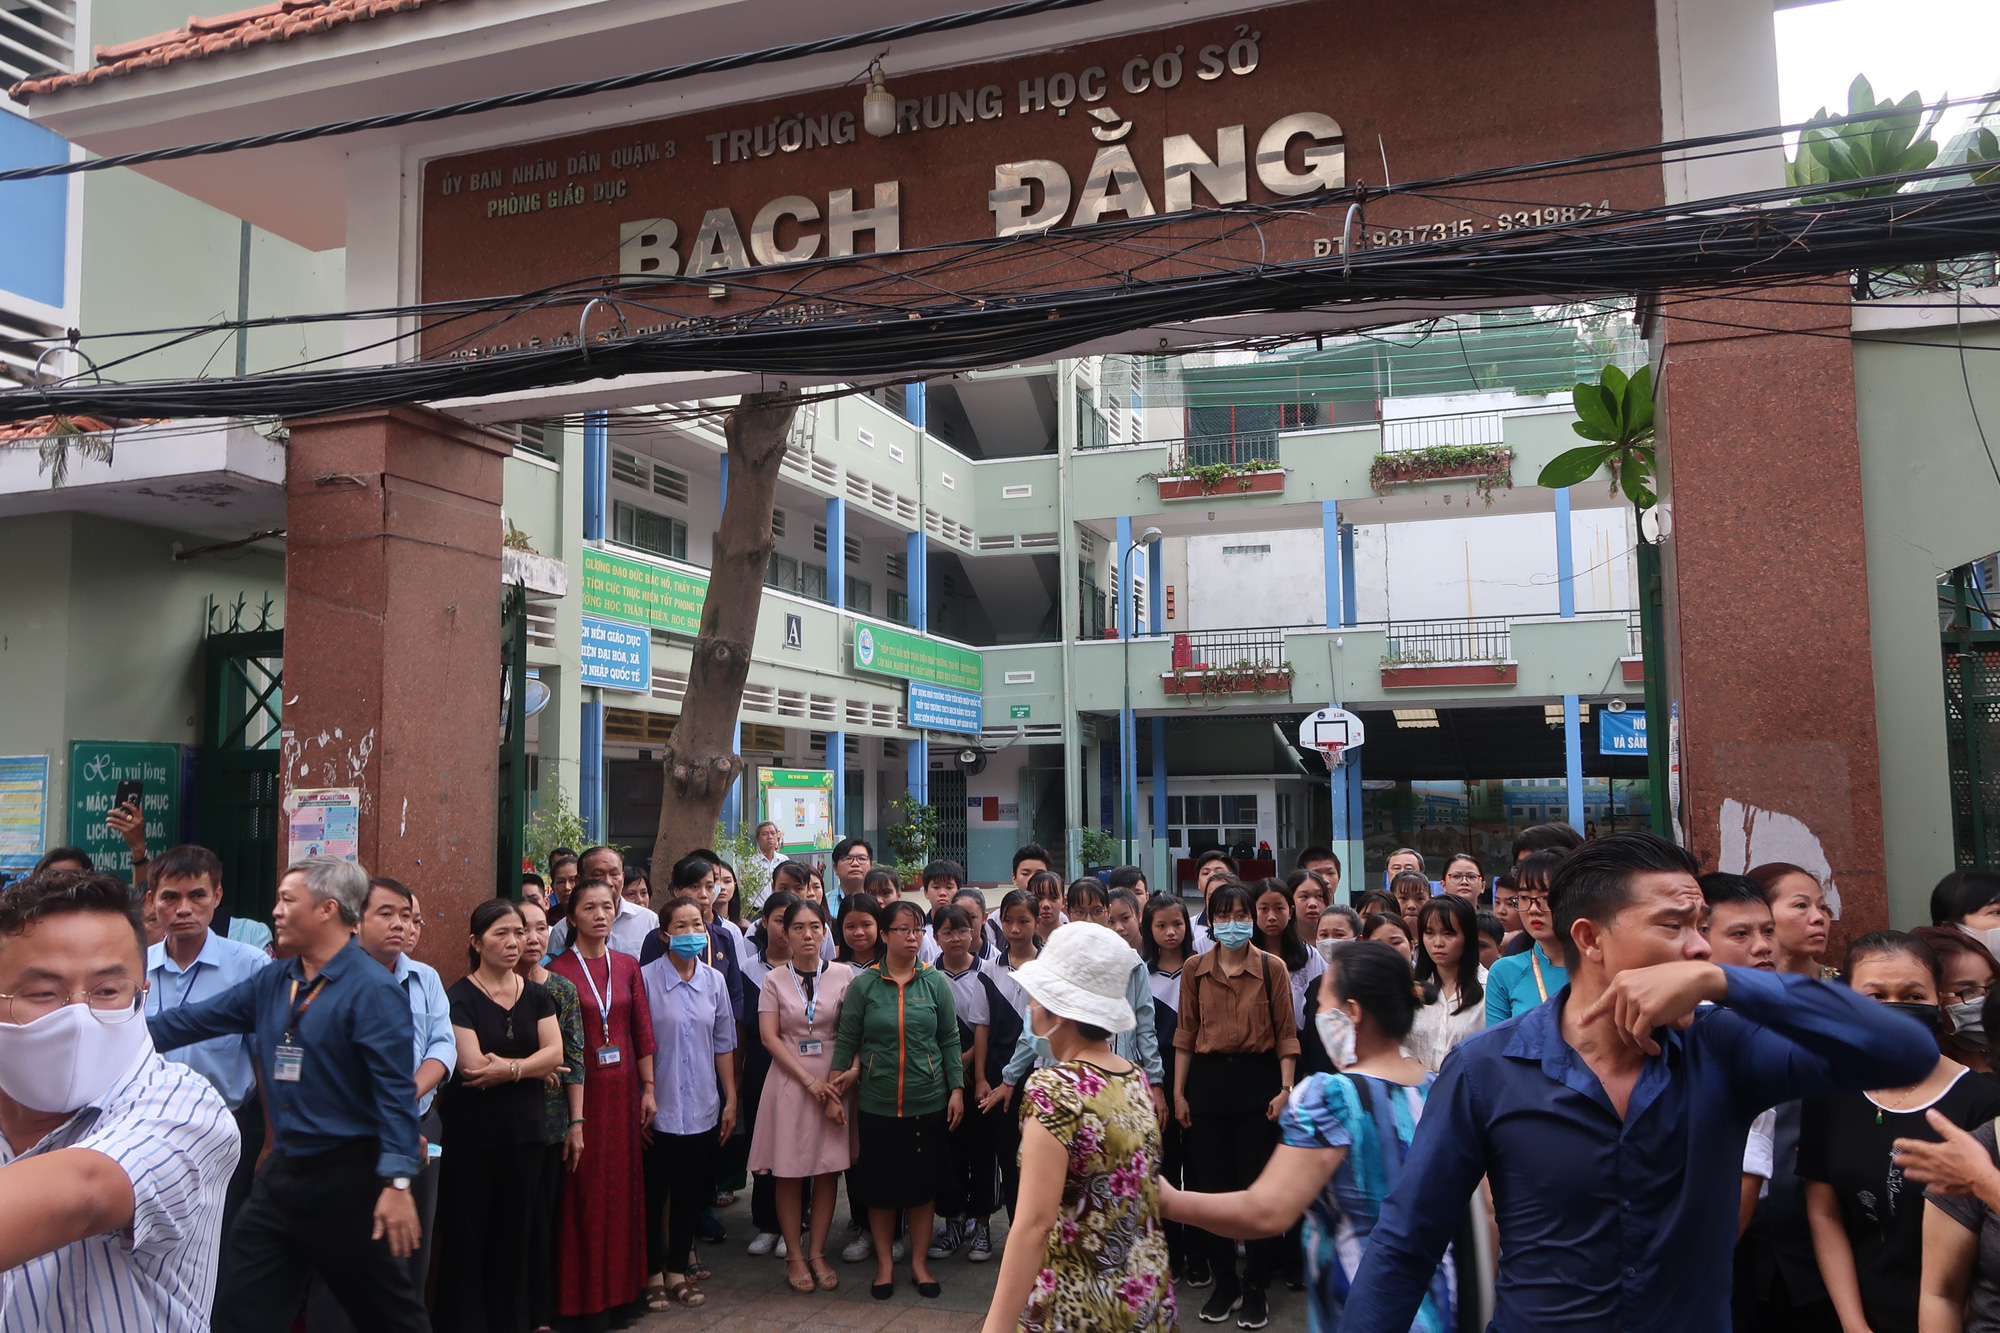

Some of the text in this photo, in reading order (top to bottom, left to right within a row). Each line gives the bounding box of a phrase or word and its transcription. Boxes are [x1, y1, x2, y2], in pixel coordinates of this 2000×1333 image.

[896, 84, 1003, 134] RUNG
[1018, 66, 1107, 117] HỌC
[1122, 45, 1185, 94] CƠ
[1196, 23, 1262, 80] SỞ
[442, 140, 676, 195] ỦY BAN NHÂN DÂN QUẬN 3
[487, 180, 627, 218] PHÒNG GIÁO DỤC
[619, 106, 1346, 299] BẠCH ĐẰNG
[1372, 218, 1474, 250] 9317315
[1498, 199, 1612, 232] 9319824
[587, 575, 604, 590] TÍCH
[612, 566, 628, 578] ĐẠO
[604, 598, 621, 613] HỌC
[607, 629, 625, 644] GIÁO
[626, 634, 641, 648] DỤC
[788, 618, 800, 645] A
[597, 647, 611, 662] ĐẠI
[589, 663, 609, 680] NHẬP
[610, 665, 630, 680] QUỐC
[631, 668, 640, 682] TẾ
[1613, 735, 1626, 749] VÀ
[83, 754, 166, 784] Xin vui lòng
[86, 791, 108, 816] MẶC
[144, 793, 169, 815] PHỤC
[86, 823, 108, 845] LỊCH
[145, 820, 166, 838] ĐÁO,
